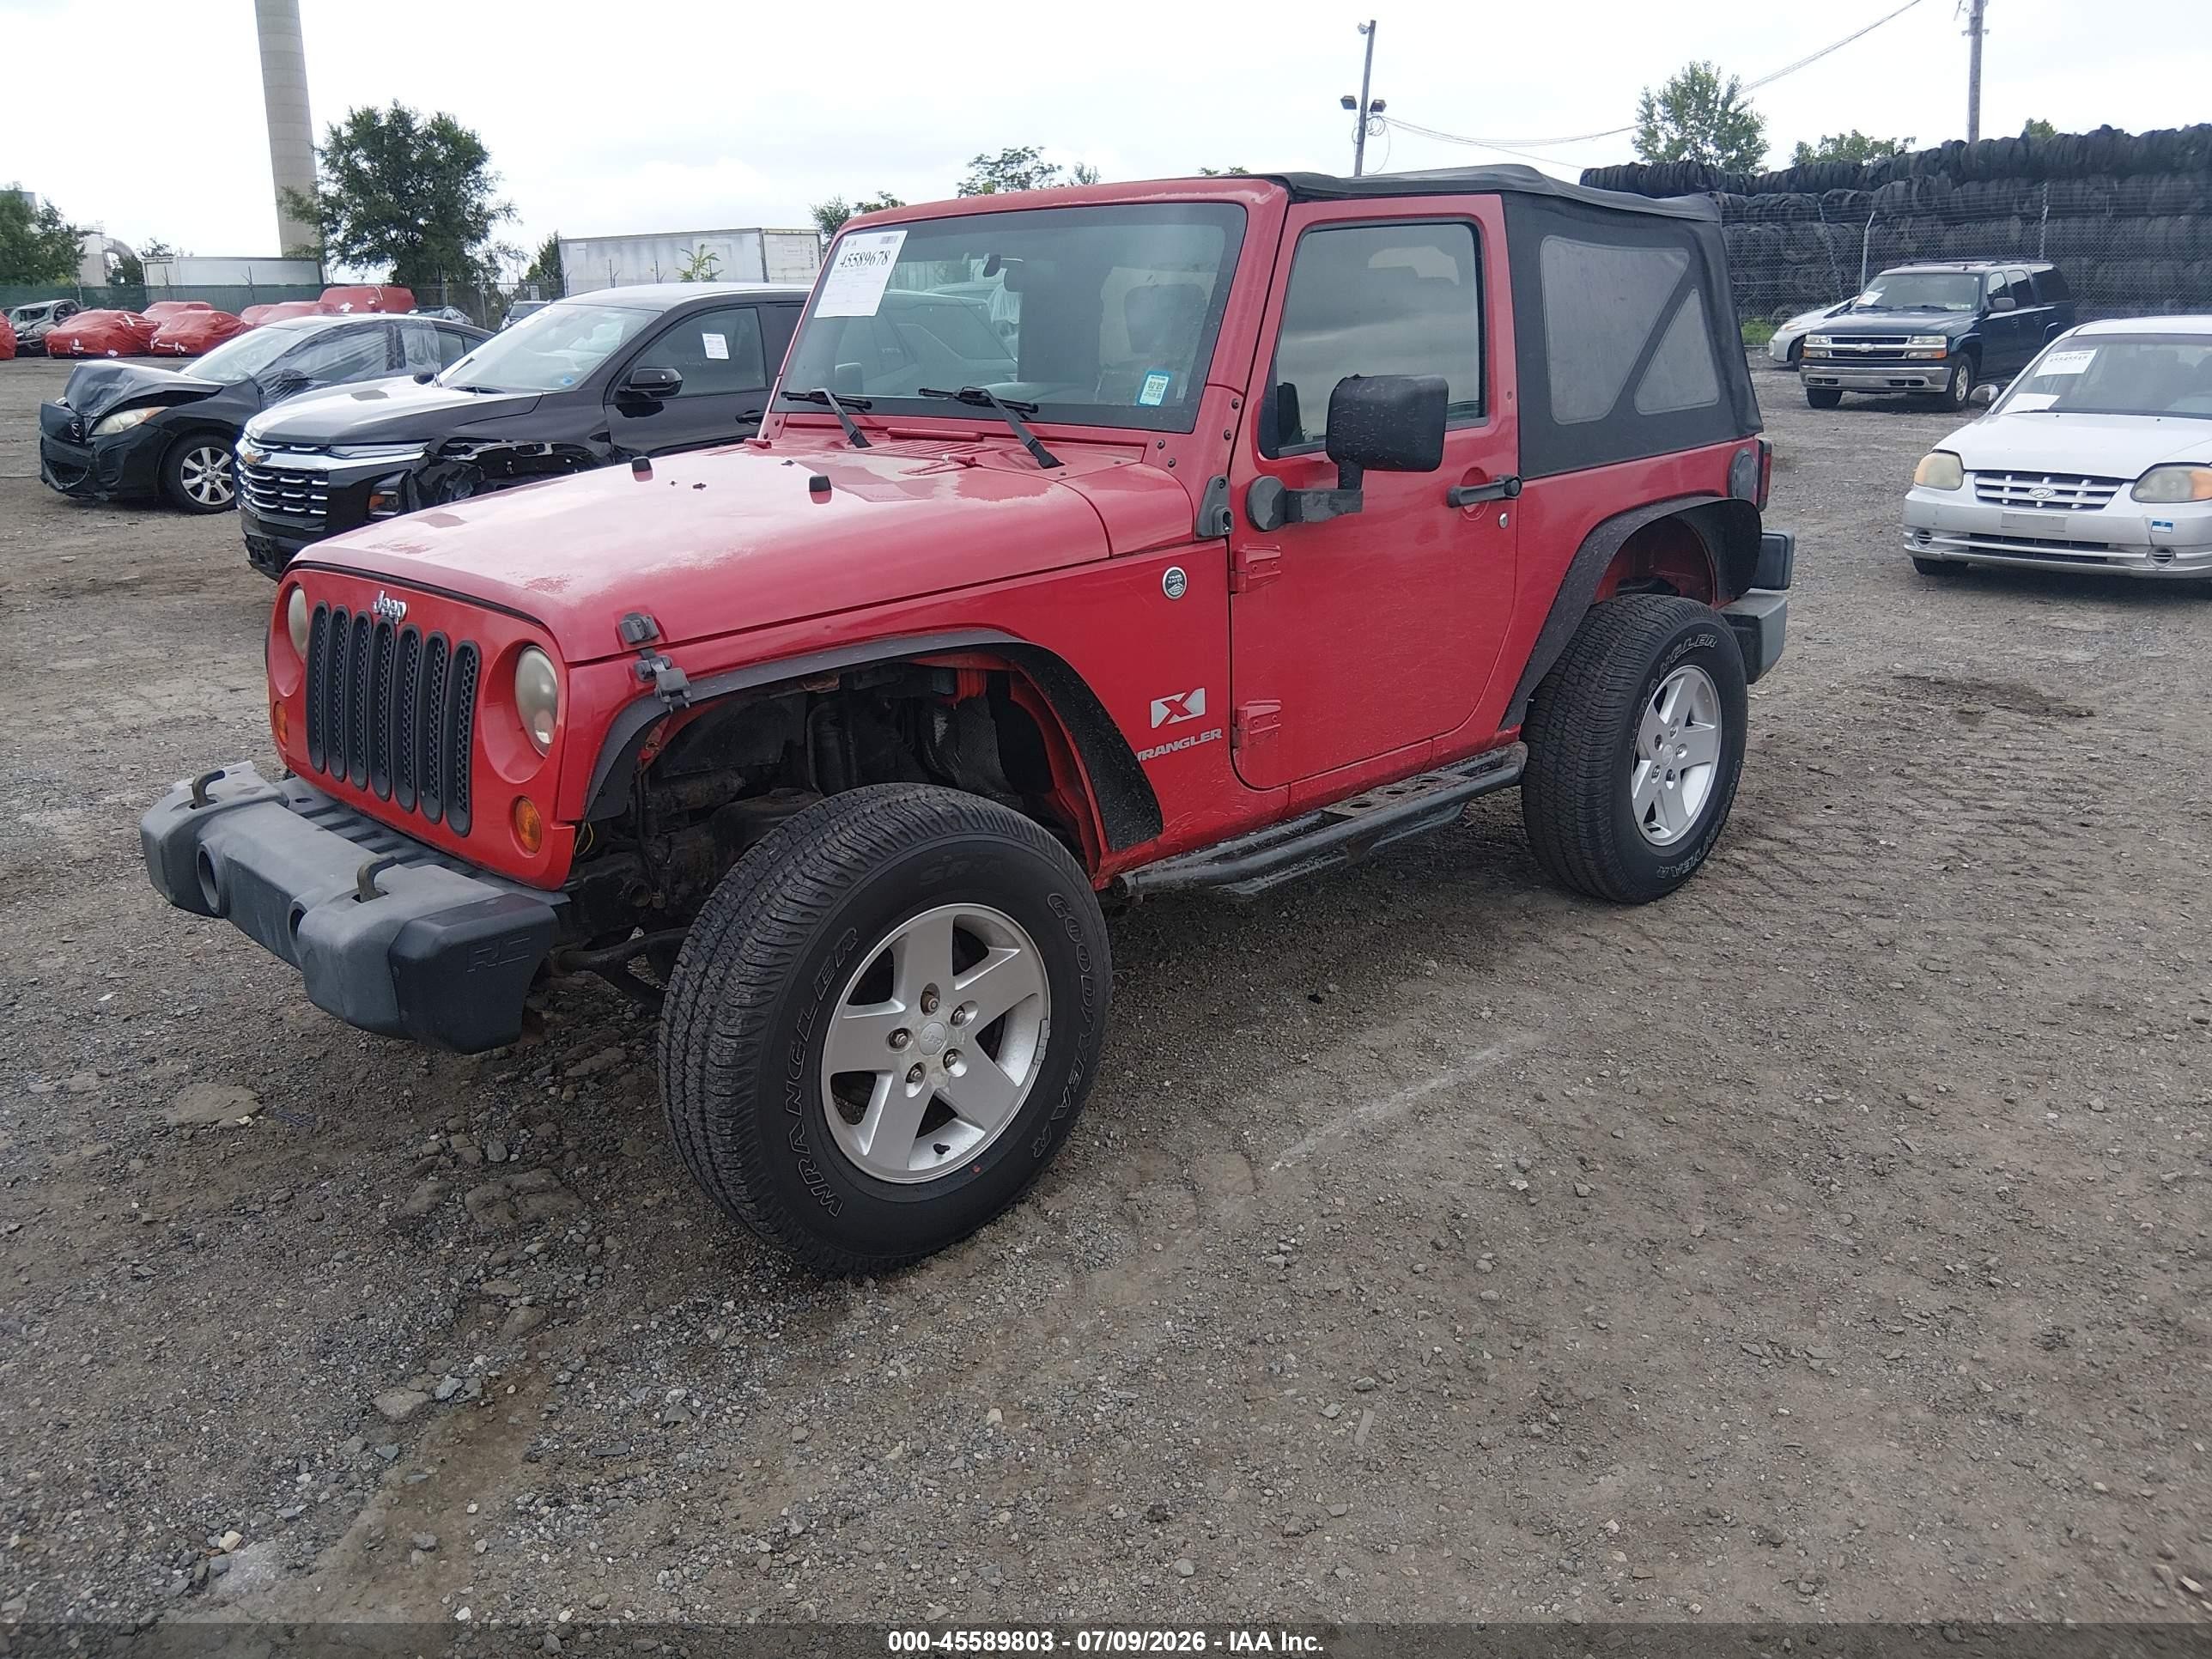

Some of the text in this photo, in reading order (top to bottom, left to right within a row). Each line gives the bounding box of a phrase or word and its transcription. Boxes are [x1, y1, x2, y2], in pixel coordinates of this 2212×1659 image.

[839, 250, 891, 268] 45589678
[373, 590, 407, 625] Jeep
[784, 927, 860, 1218] WRANGLER
[1030, 892, 1097, 1160] GOODYEAR
